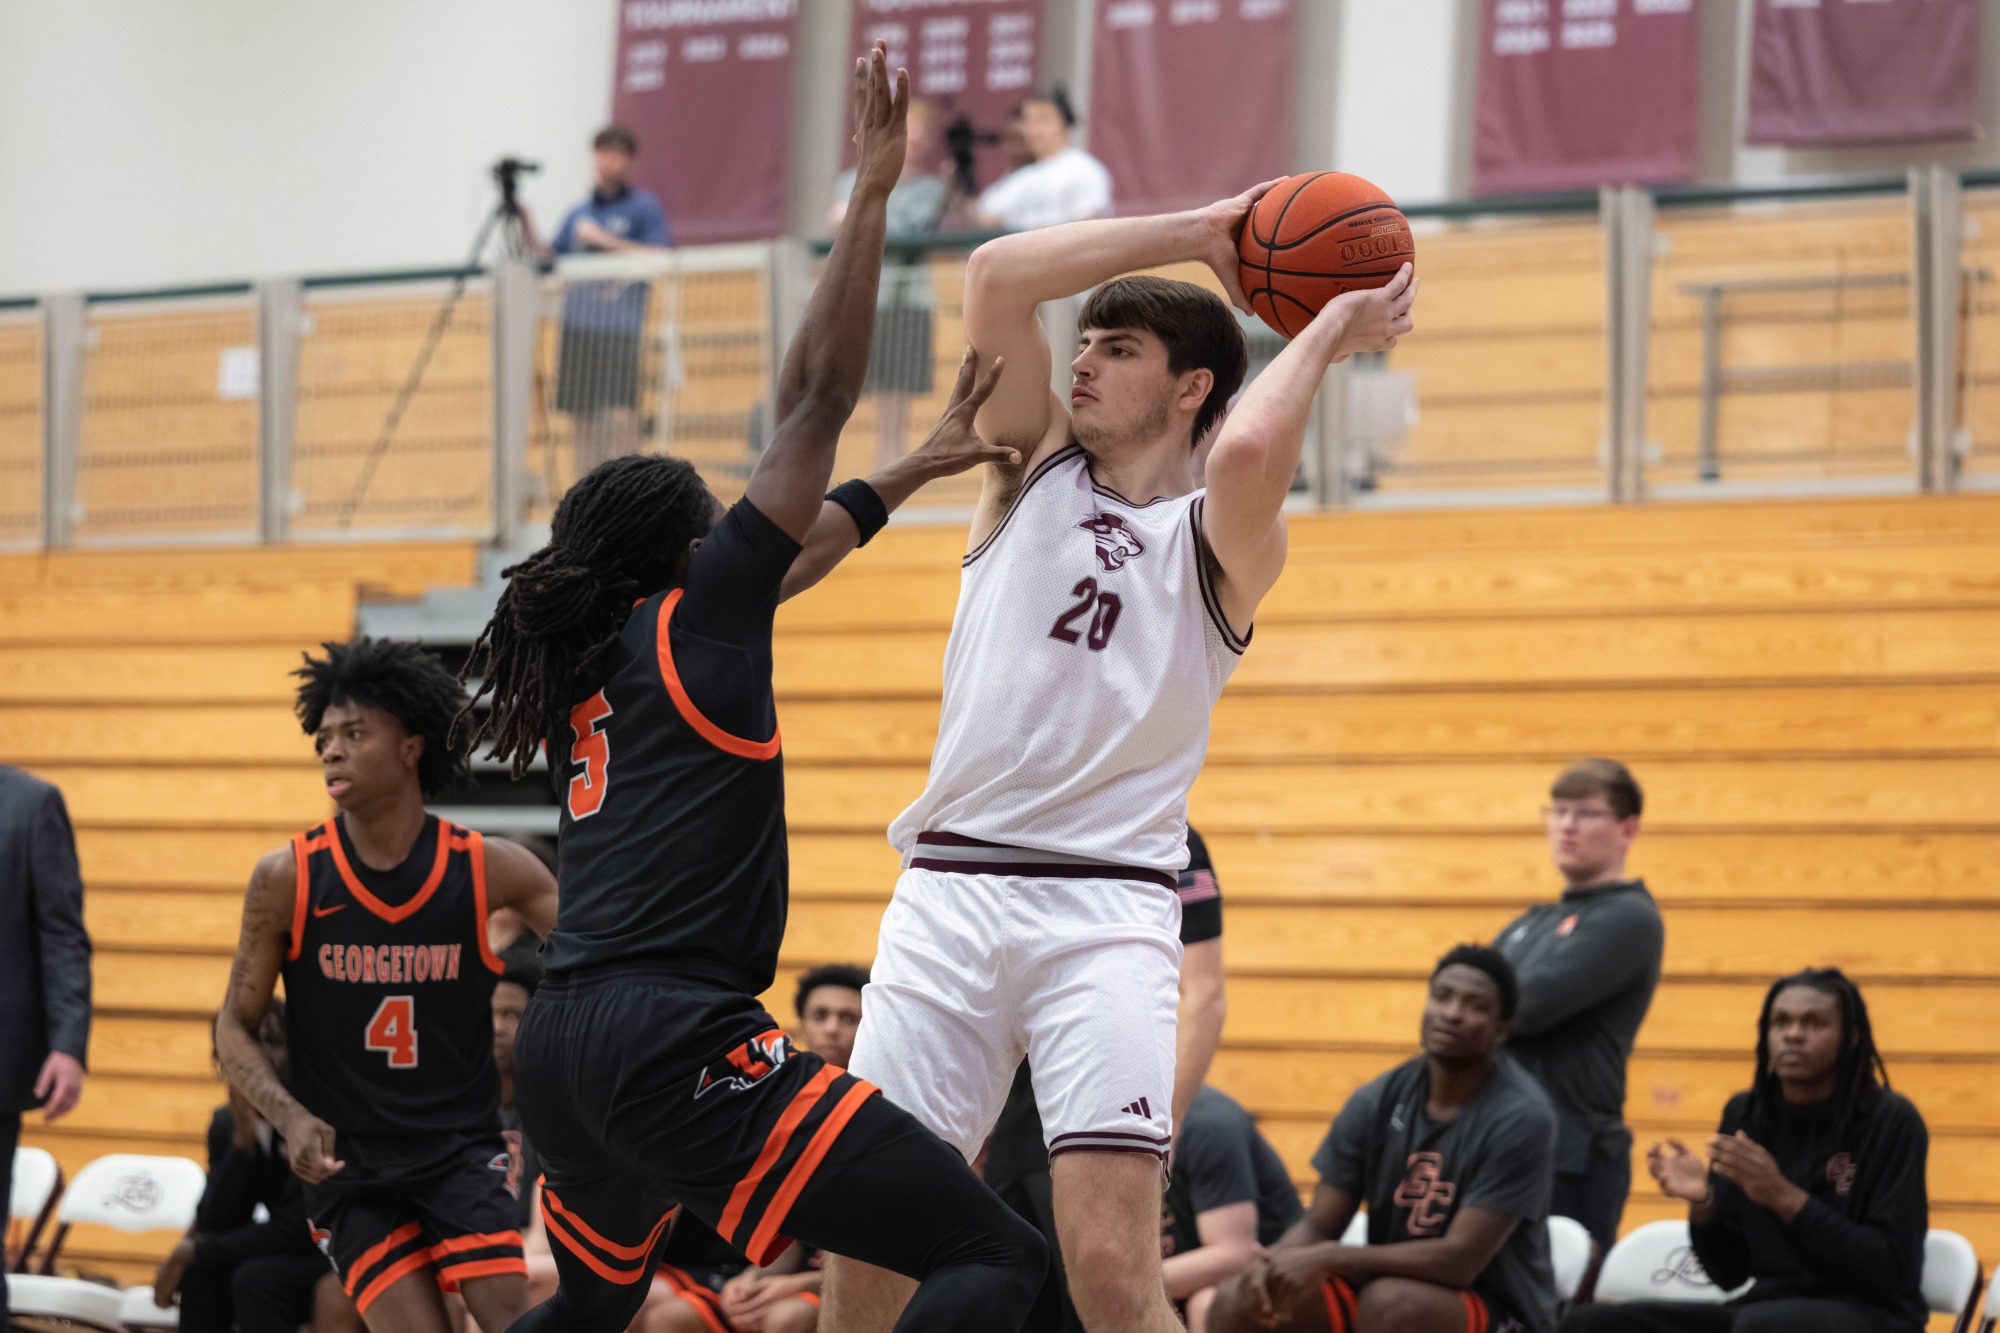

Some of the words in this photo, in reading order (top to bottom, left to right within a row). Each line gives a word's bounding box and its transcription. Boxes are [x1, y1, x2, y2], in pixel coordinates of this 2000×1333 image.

[1348, 219, 1373, 228] DESIGN
[1048, 576, 1123, 652] 20
[568, 687, 613, 821] 5
[318, 943, 462, 984] GEORGETOWN
[364, 995, 418, 1069] 4
